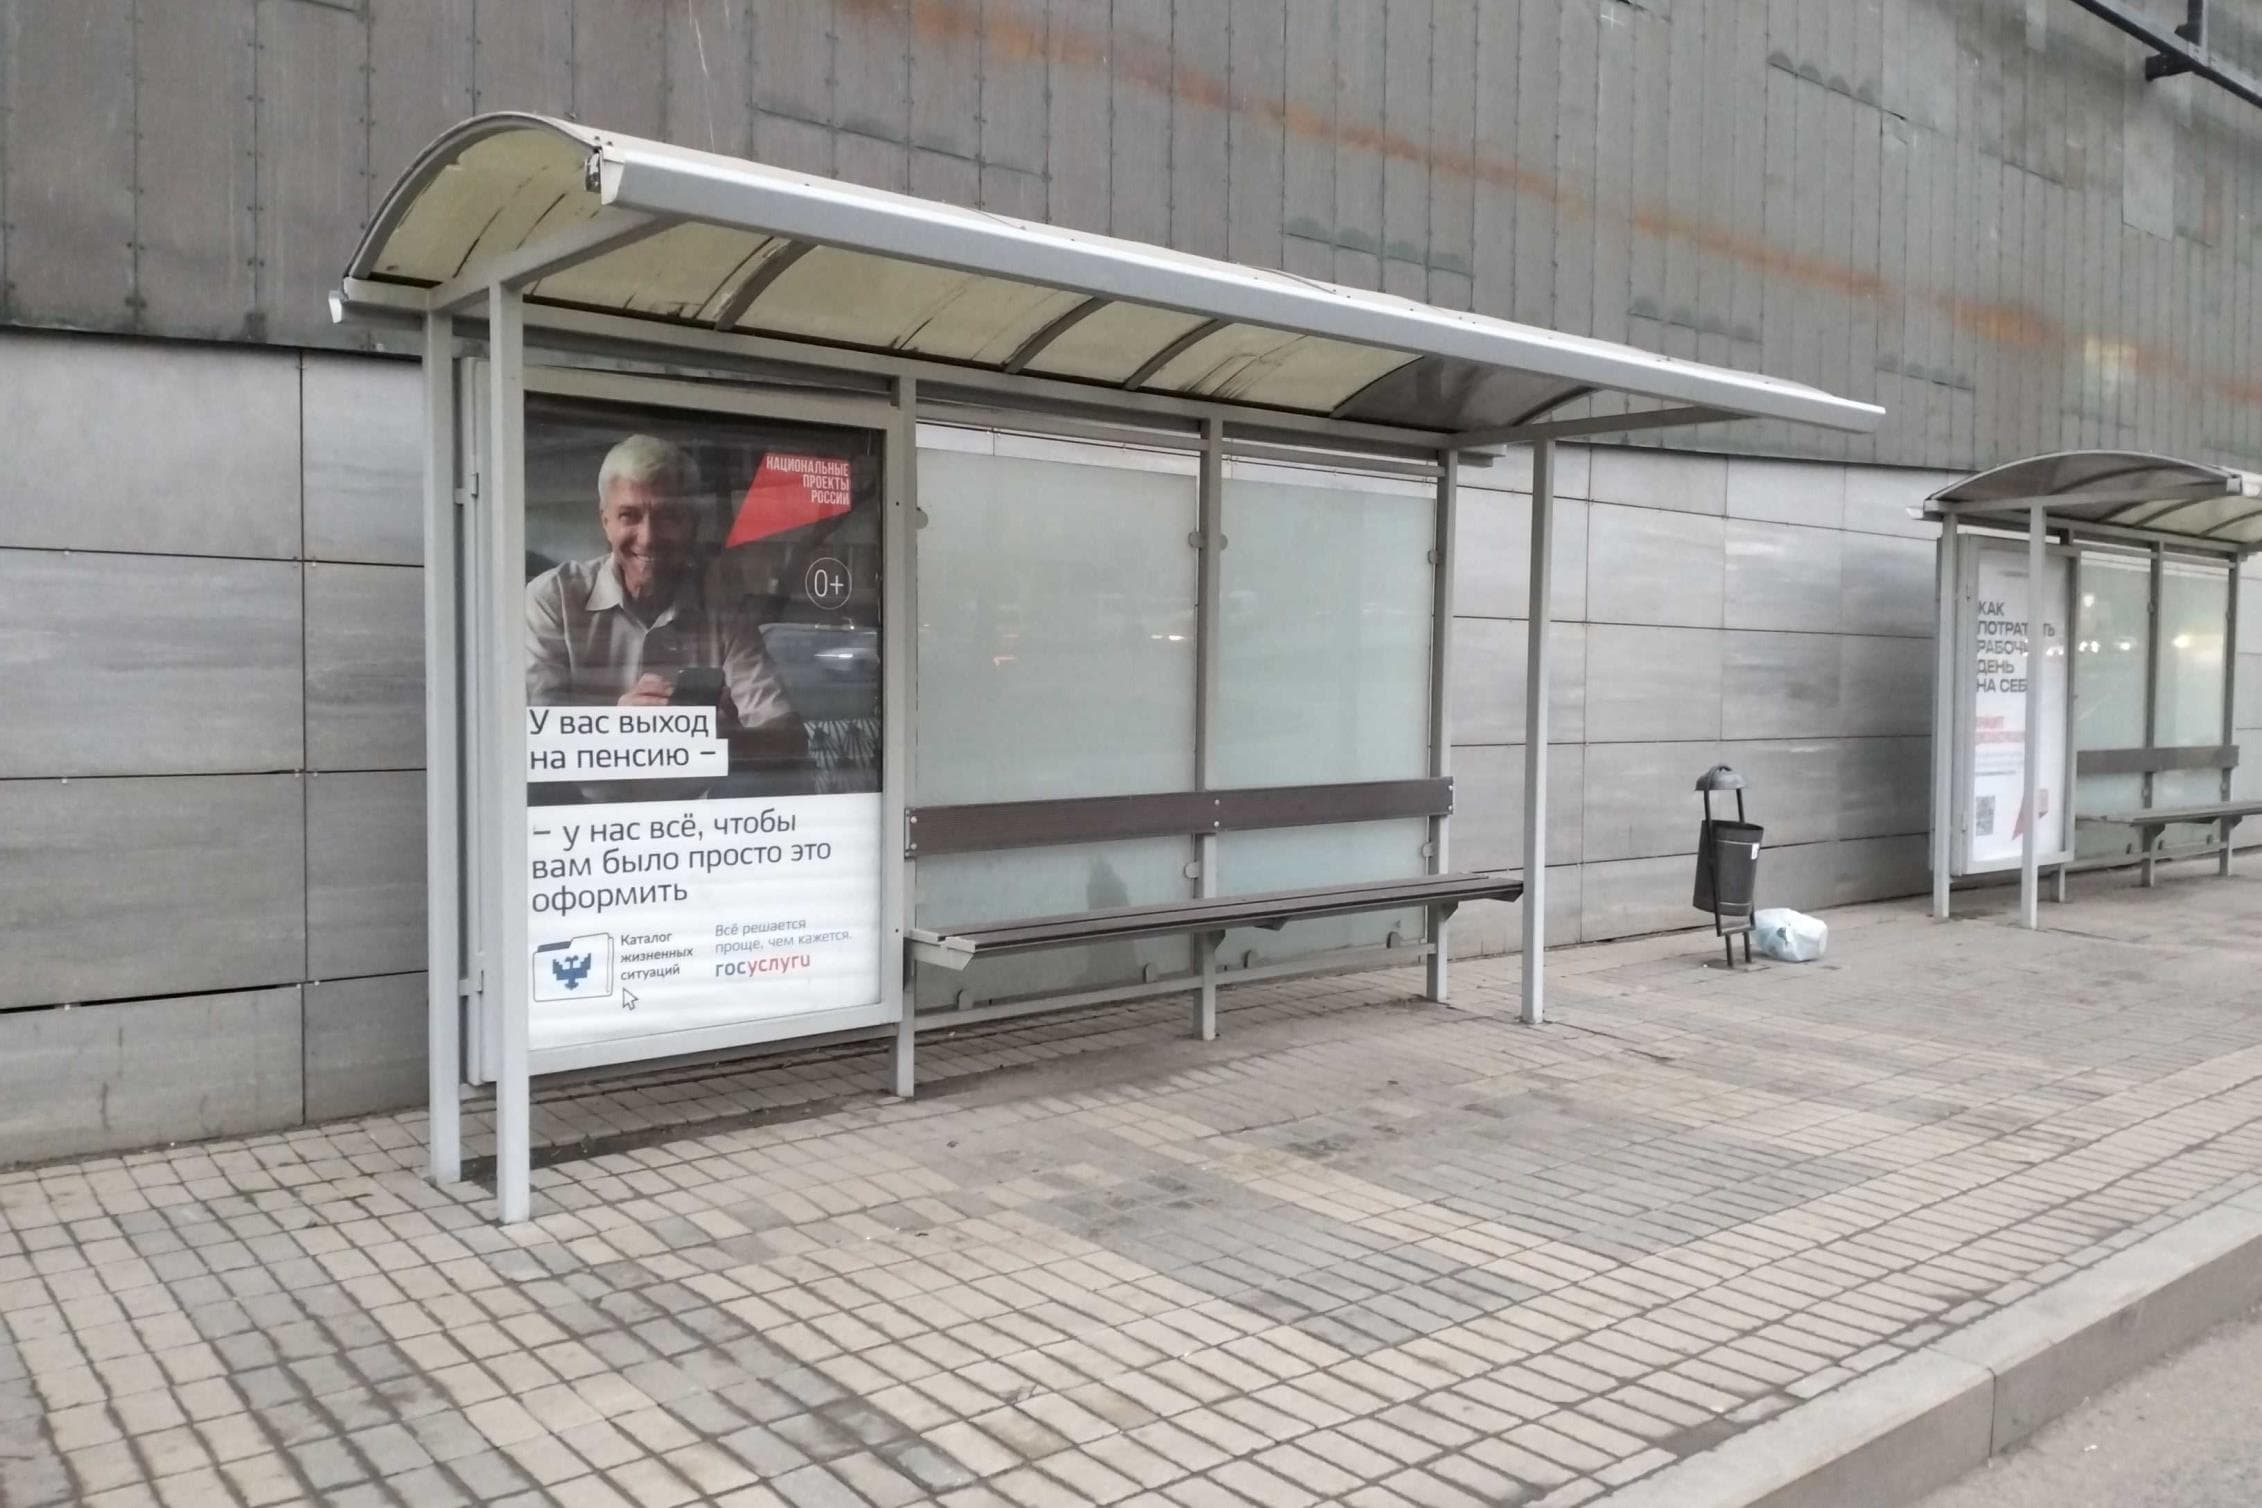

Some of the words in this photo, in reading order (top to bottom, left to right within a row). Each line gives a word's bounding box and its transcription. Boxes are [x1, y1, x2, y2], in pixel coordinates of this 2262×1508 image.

[766, 455, 849, 476] НАЦИОНАЛЬНЫЕ
[803, 474, 850, 491] ПРОЕКТЫ
[811, 489, 850, 505] РОССИИ
[814, 569, 844, 597] 0+
[1978, 601, 2006, 616] КАК
[1977, 620, 2055, 637] ПОТРАТТЬ
[1978, 659, 2015, 675] ДЕНЬ
[1976, 678, 1996, 693] НА
[2000, 678, 2028, 693] СЕБ
[529, 709, 549, 735] У
[560, 714, 610, 734] вас
[619, 714, 709, 737] выход
[530, 750, 566, 769] на
[577, 747, 690, 768] пенсию
[563, 824, 580, 851] у
[590, 821, 641, 842] нас
[650, 813, 704, 841] всё,
[714, 807, 797, 835] чтобы
[532, 856, 592, 879] вам
[602, 847, 680, 874] было
[689, 844, 782, 873] просто
[791, 842, 832, 861] это
[532, 882, 689, 917] оформить
[715, 923, 739, 937] Всё
[743, 919, 807, 937] решается
[620, 931, 673, 946] Каталог
[715, 938, 765, 954] проще,
[768, 936, 795, 948] чем
[798, 930, 853, 947] кажется.
[620, 947, 694, 964] жизненных
[620, 963, 681, 981] ситуаций
[715, 953, 811, 978] госуслуги
